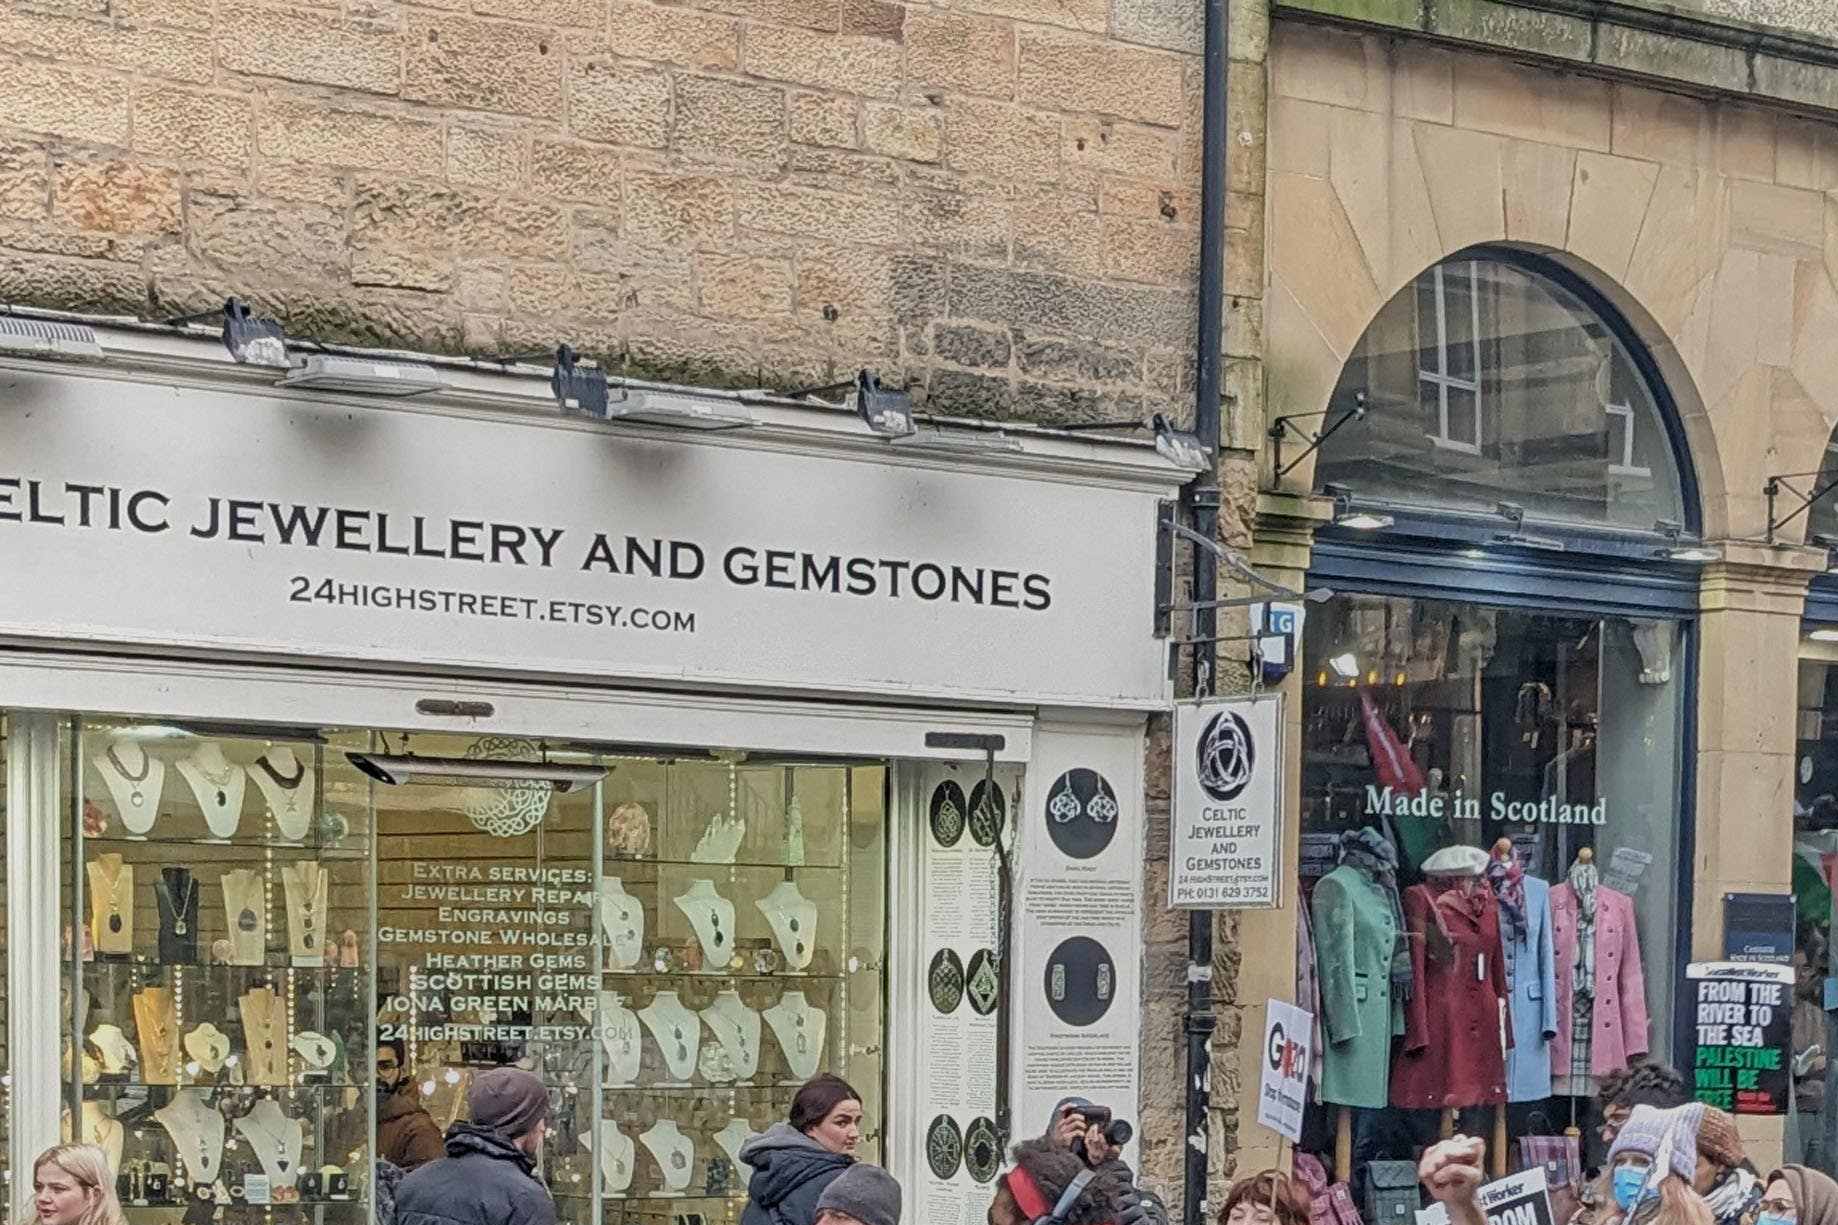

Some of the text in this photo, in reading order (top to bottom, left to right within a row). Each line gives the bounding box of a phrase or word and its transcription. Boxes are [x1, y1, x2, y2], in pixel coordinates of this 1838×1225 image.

[0, 475, 1052, 612] ELTIC JEWELLERY AND GEMSTONES
[289, 575, 696, 634] 24HIGHSTREET.ETSY.COM
[1202, 807, 1247, 822] CELTIC
[1364, 785, 1607, 826] Made in Scotland
[1188, 825, 1261, 840] JEWELLERY
[1211, 842, 1238, 855] AND
[414, 863, 593, 883] EXTRA SERVICES:
[1186, 857, 1262, 871] GEMSTONES
[401, 884, 526, 902] JEWELLERY
[438, 907, 570, 925] ENGRAVINGS
[378, 927, 492, 945] GEMSTONE
[426, 953, 586, 970] HEATHER GEMS
[413, 974, 531, 991] SCOTTISH
[1698, 981, 1782, 1006] FROM THE
[386, 996, 528, 1012] IONA GREEN
[1696, 1003, 1772, 1027] RIVER TO
[1696, 1025, 1764, 1048] THE SEA
[1695, 1047, 1783, 1070] PALESTINE
[1695, 1069, 1760, 1090] WILL BE
